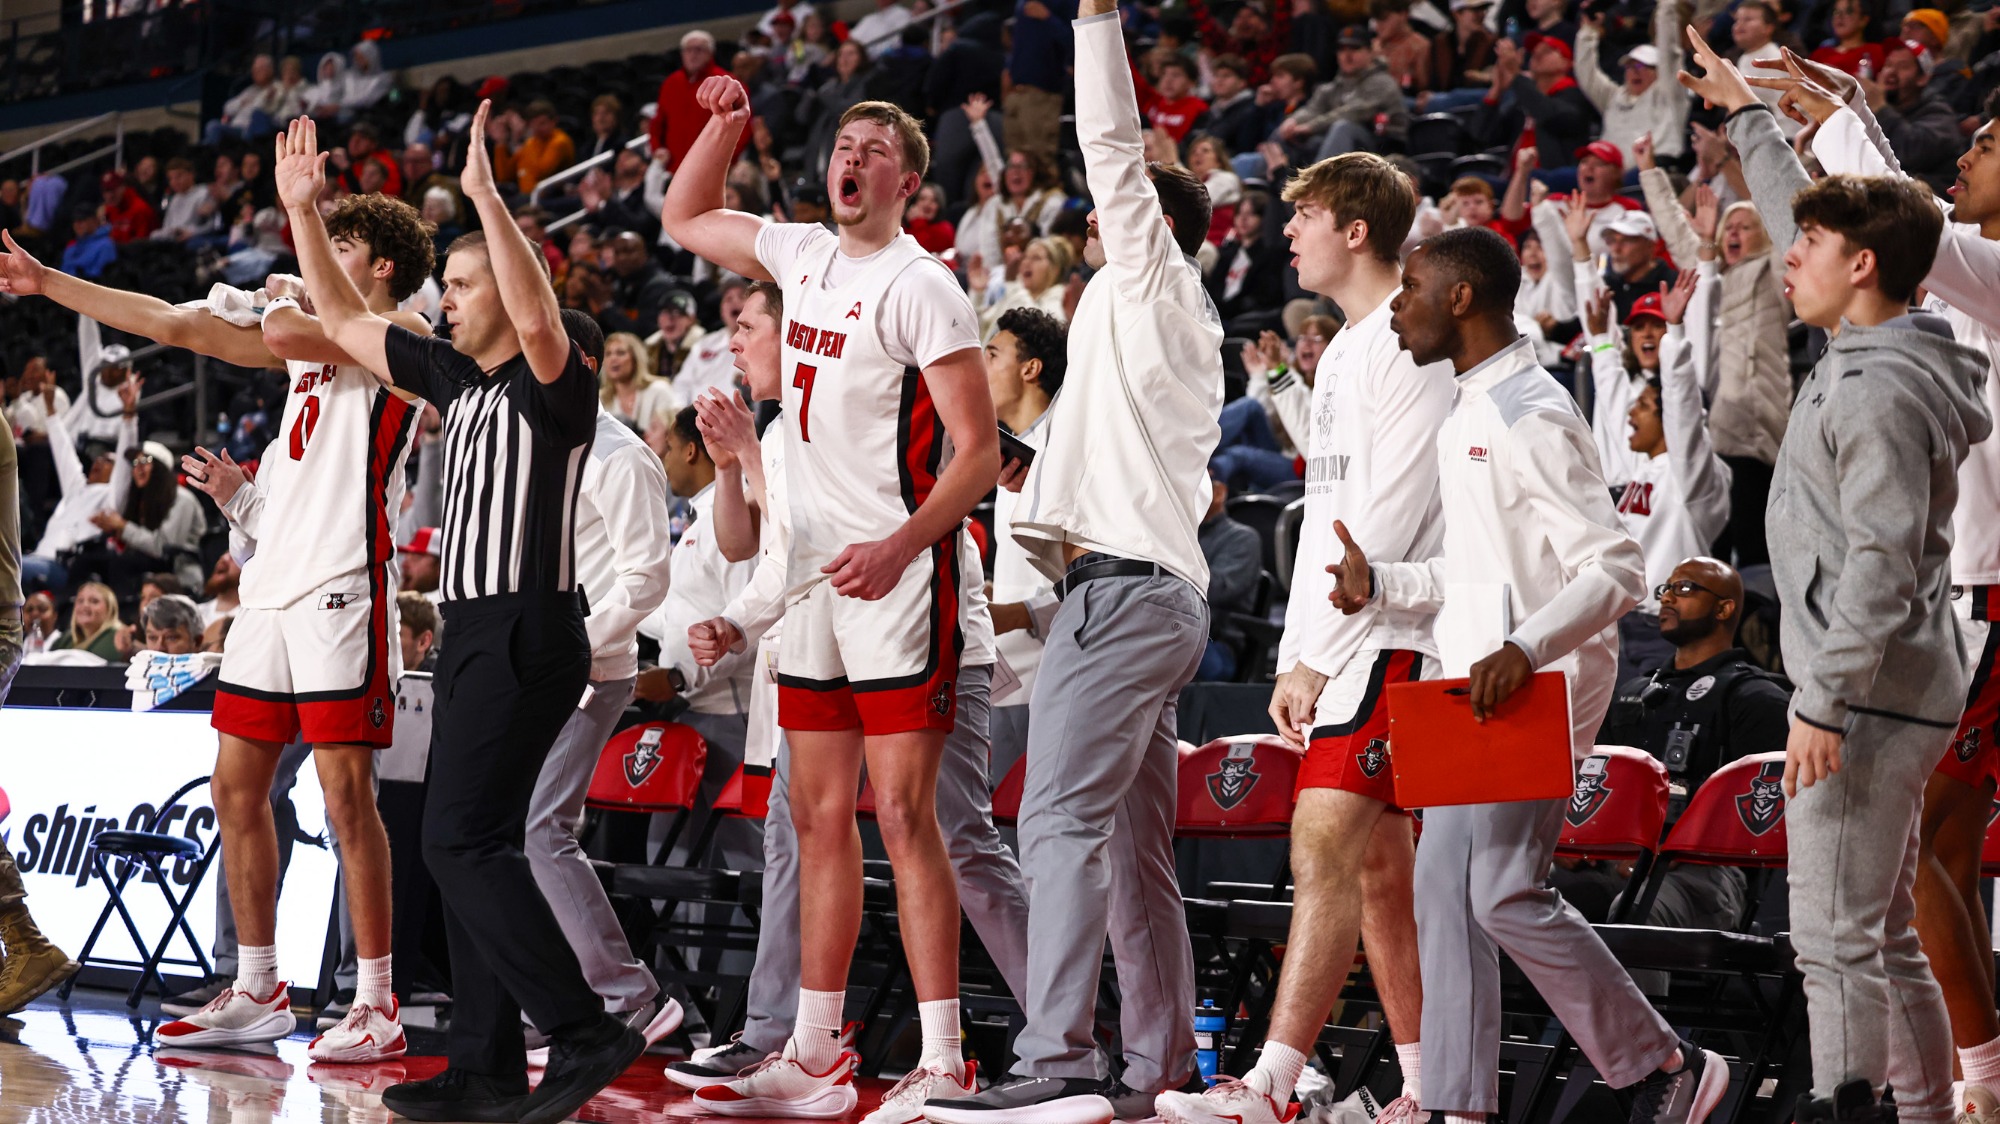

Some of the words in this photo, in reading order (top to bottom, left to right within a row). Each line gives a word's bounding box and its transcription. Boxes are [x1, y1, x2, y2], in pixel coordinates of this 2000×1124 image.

[786, 318, 818, 353] USTIN
[815, 329, 847, 359] PEAY
[289, 394, 320, 461] 0
[793, 361, 817, 443] 7
